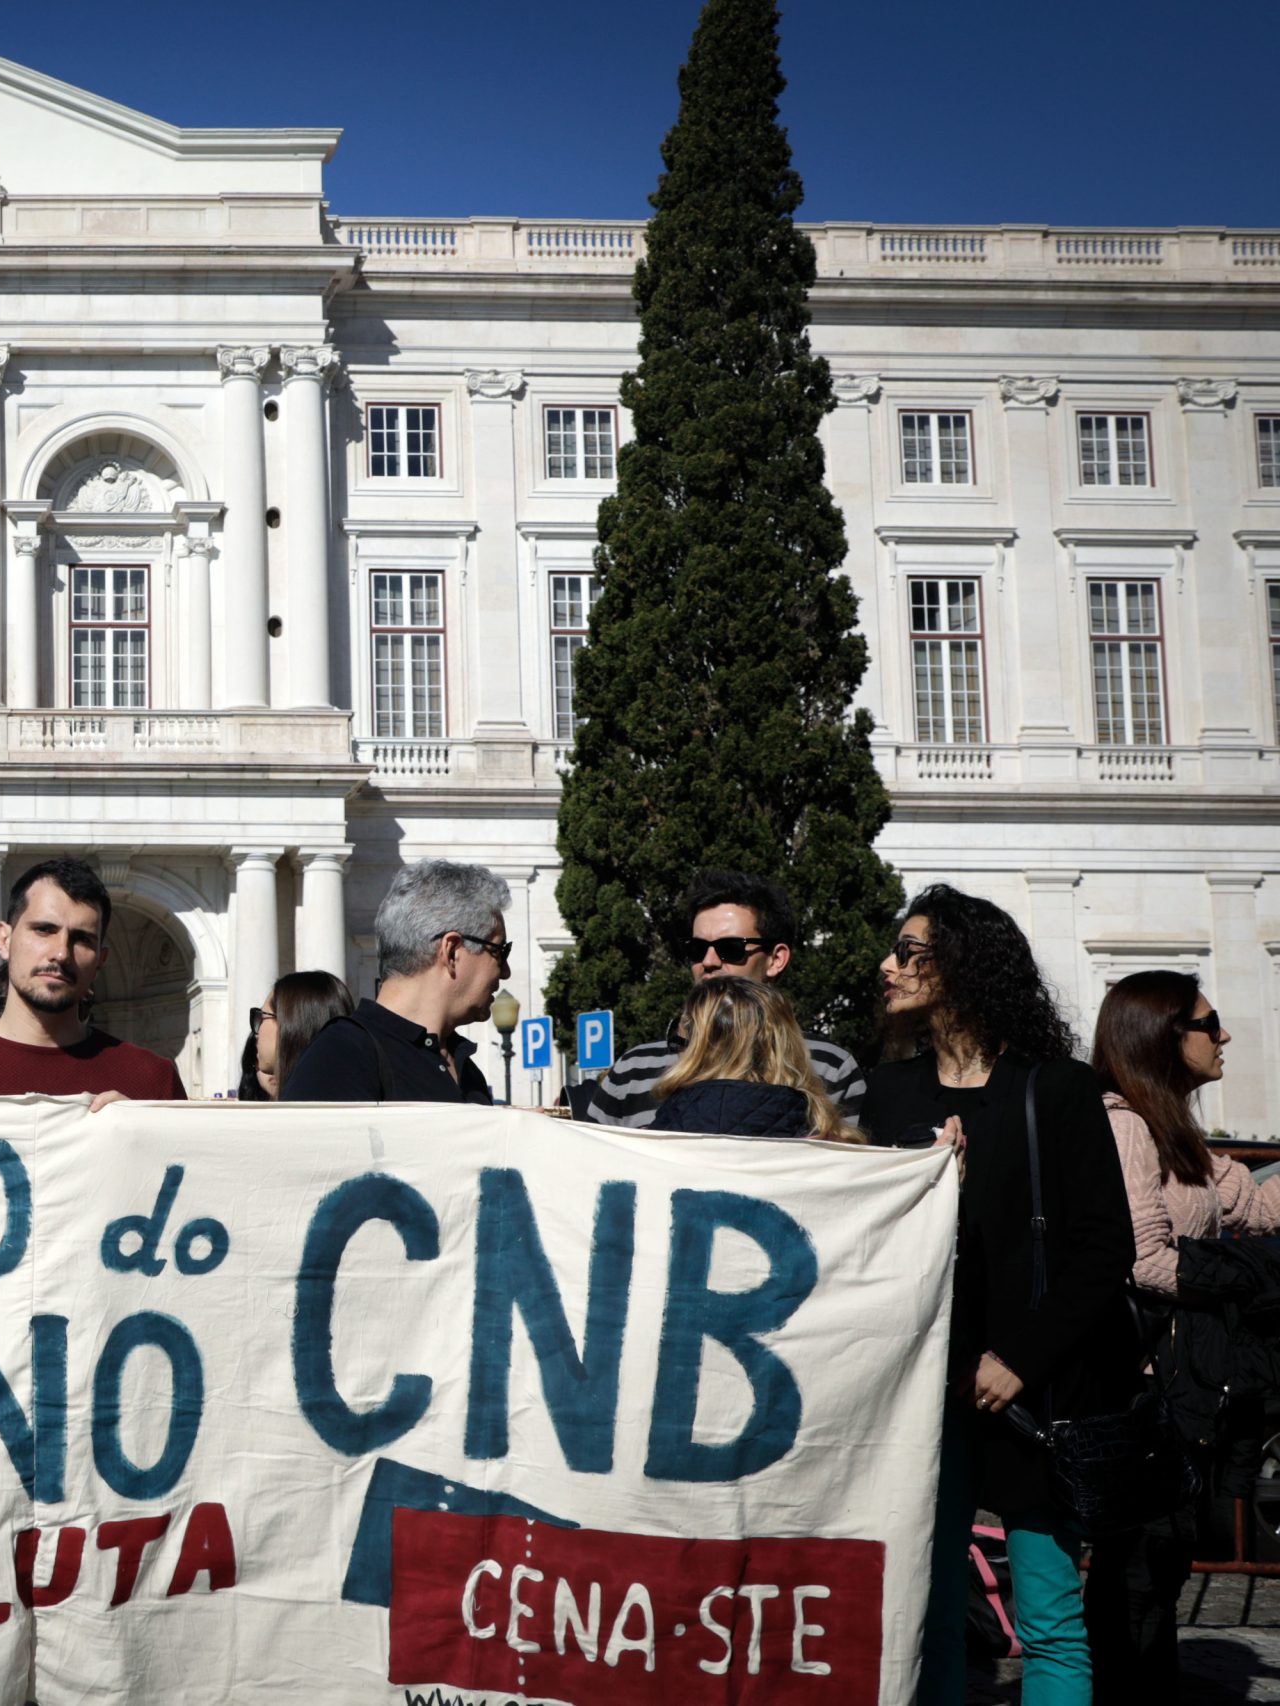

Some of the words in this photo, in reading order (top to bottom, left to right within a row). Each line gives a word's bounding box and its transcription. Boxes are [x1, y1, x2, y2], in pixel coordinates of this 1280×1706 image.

[527, 1023, 545, 1064] P
[585, 1020, 603, 1059] P
[100, 1165, 229, 1275] do
[293, 1169, 818, 1482] CNB
